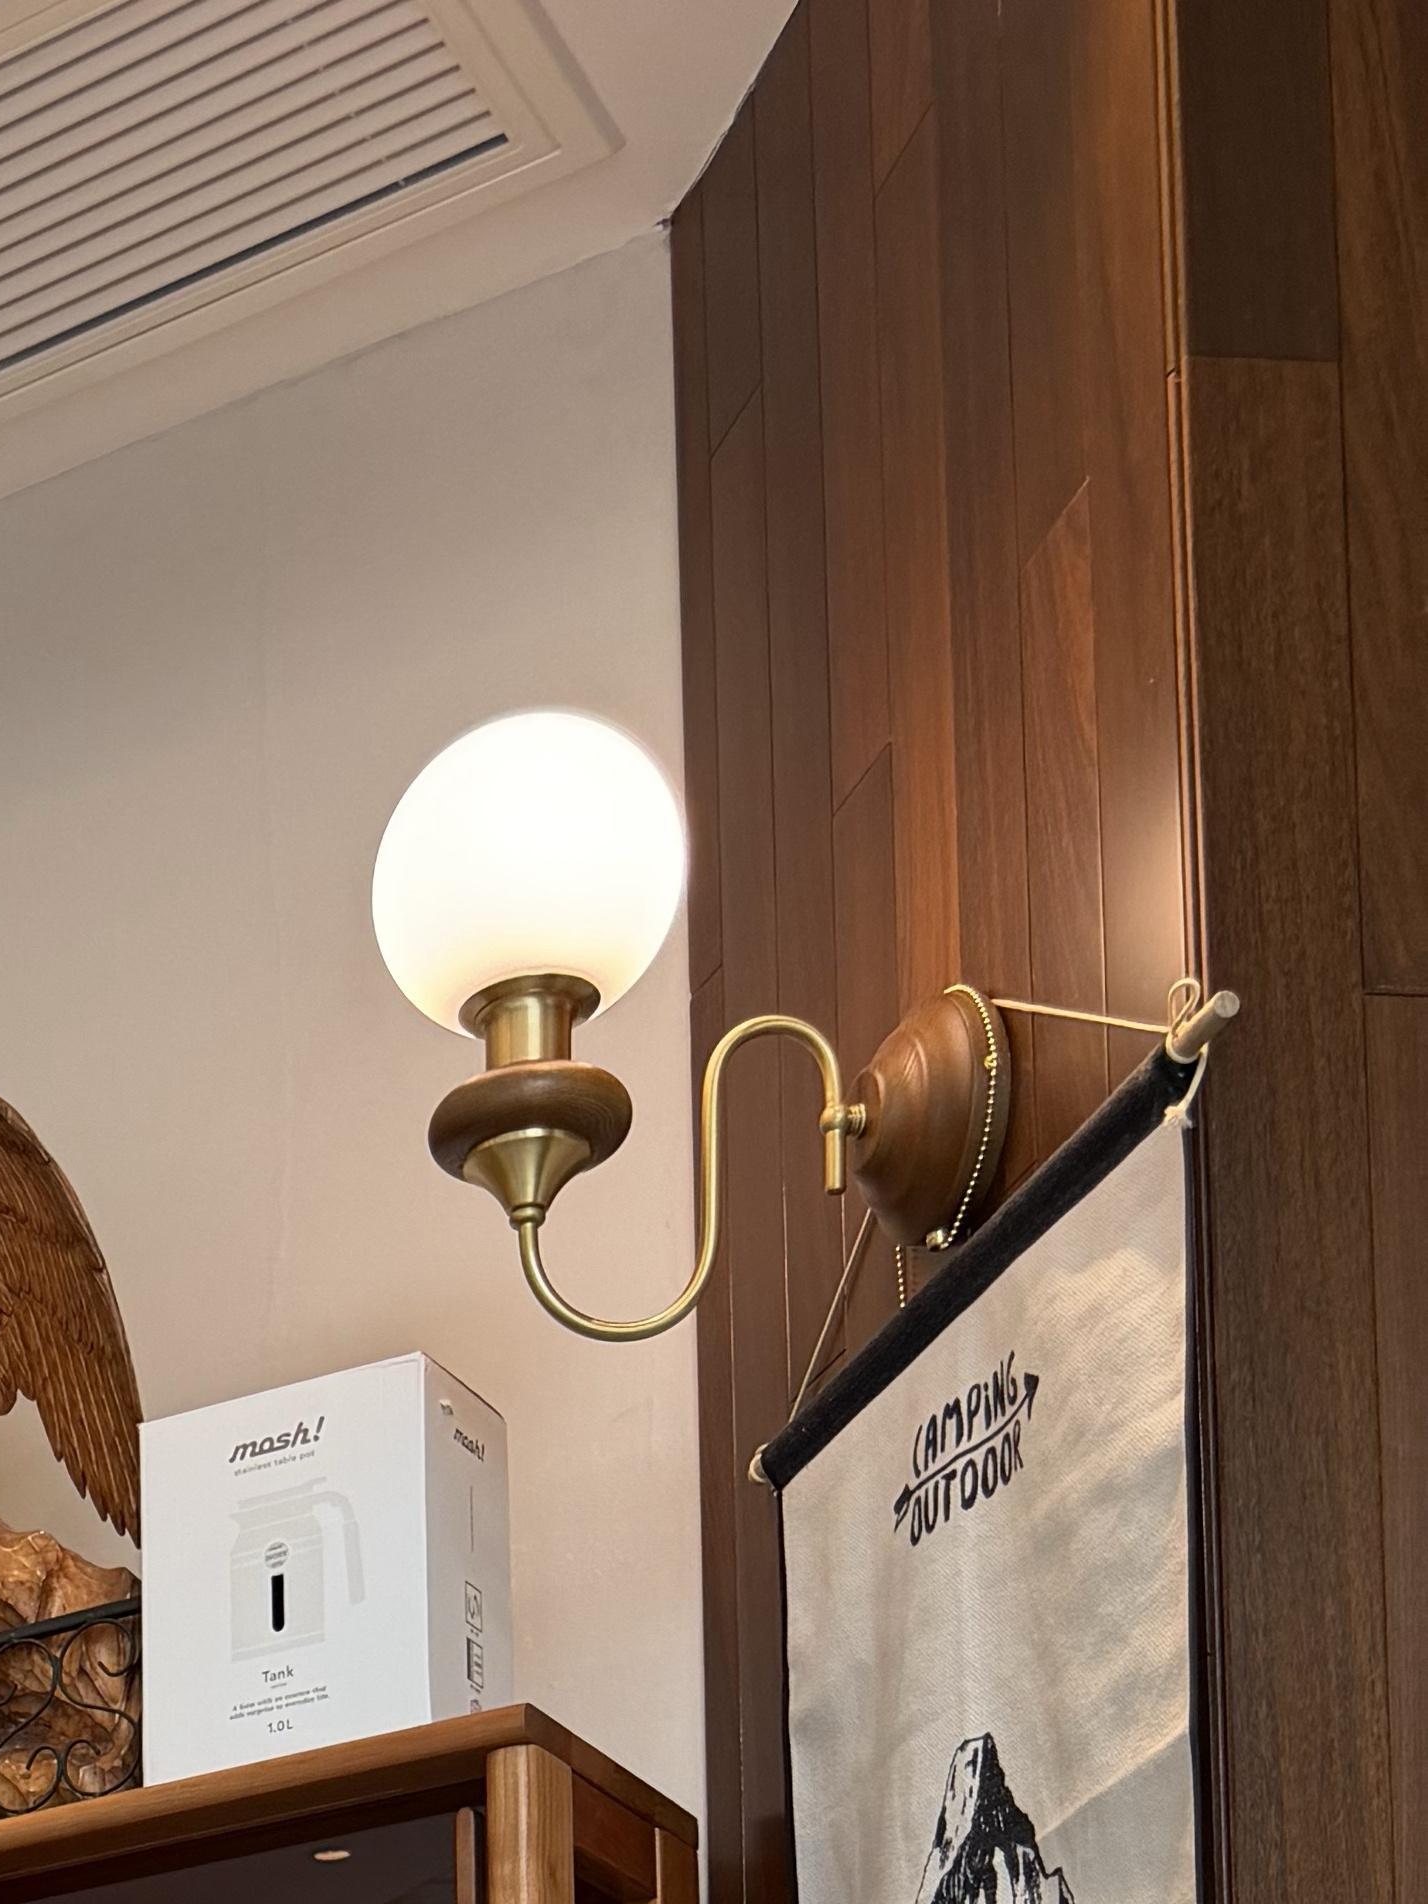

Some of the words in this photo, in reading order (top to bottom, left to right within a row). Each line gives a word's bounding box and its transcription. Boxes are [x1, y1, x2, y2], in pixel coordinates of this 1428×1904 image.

[228, 1415, 325, 1464] mosh!
[299, 1449, 316, 1461] pot
[910, 1421, 1025, 1546] OUTDOOR
[261, 1665, 294, 1683] Tank
